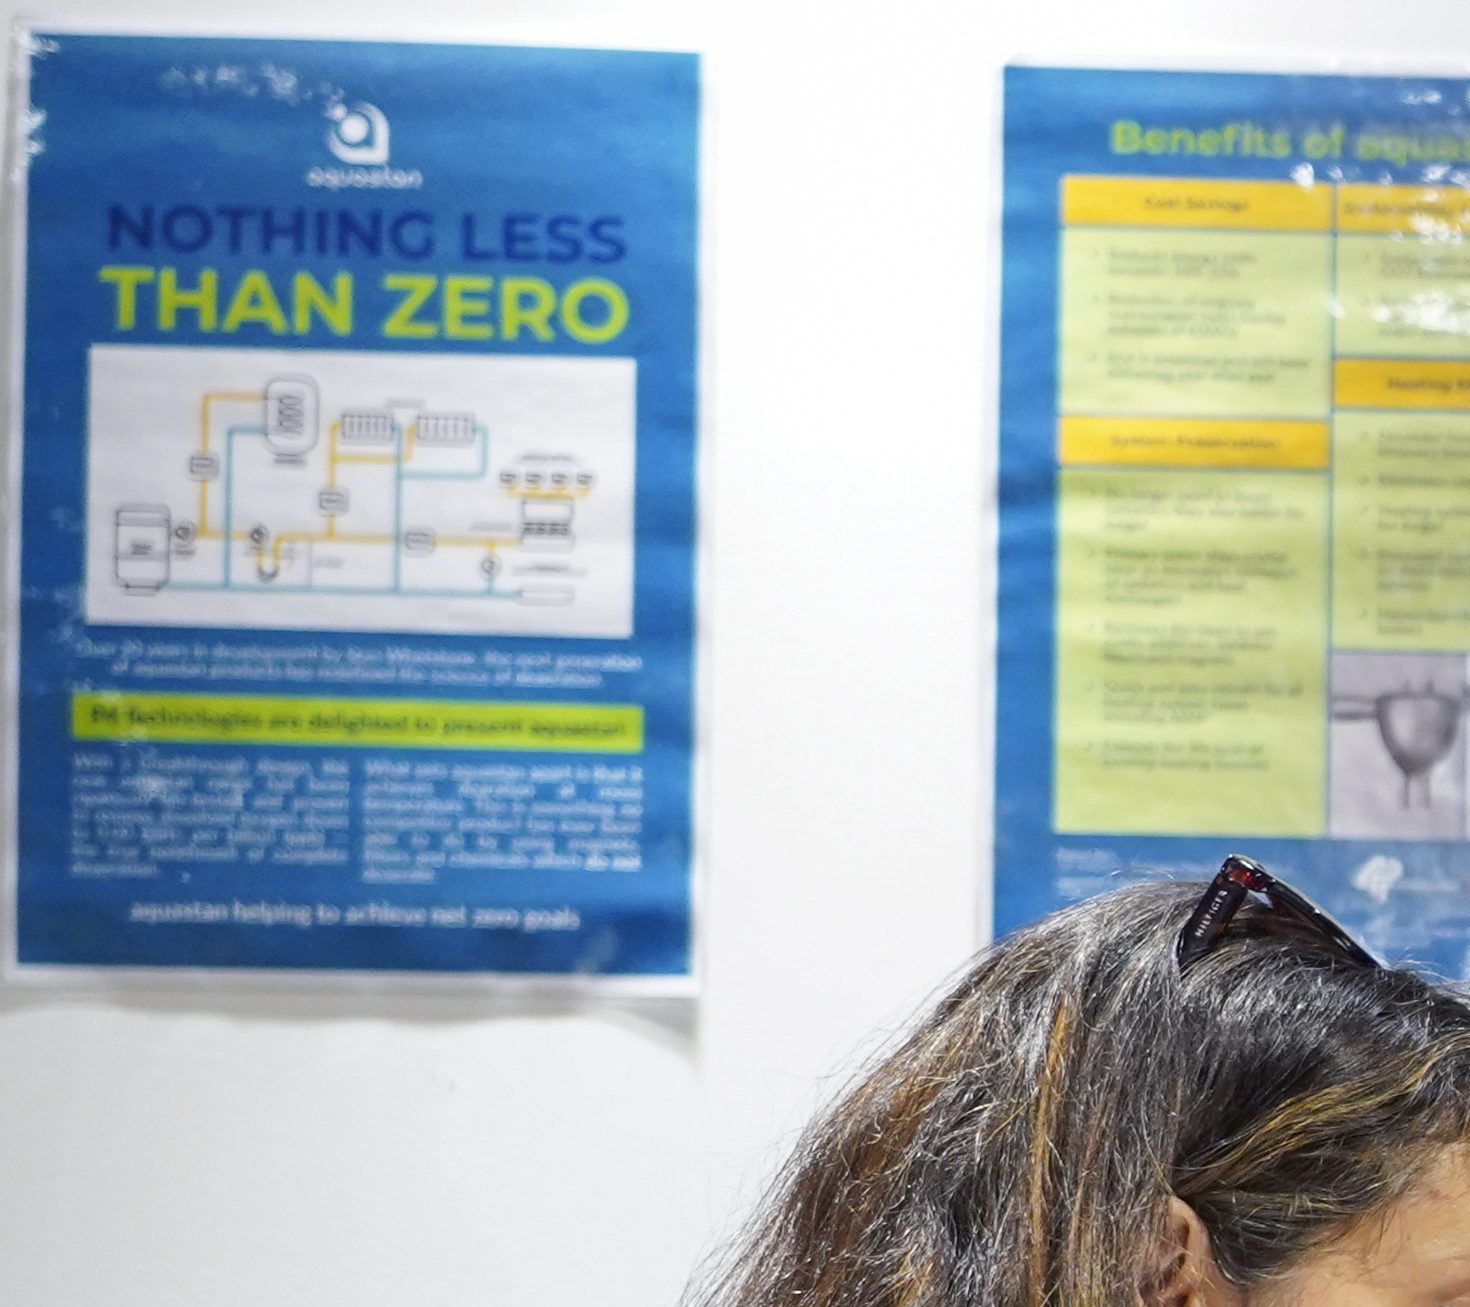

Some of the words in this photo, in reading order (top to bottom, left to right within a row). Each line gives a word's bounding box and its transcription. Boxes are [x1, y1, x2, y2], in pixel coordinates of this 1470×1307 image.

[1109, 119, 1291, 160] Benefits
[1303, 124, 1344, 160] of
[106, 203, 435, 261] NOTHING
[461, 211, 627, 265] LESS
[98, 265, 354, 337] THAN
[382, 274, 630, 343] ZERO
[232, 897, 312, 929] helping
[316, 902, 341, 925] to
